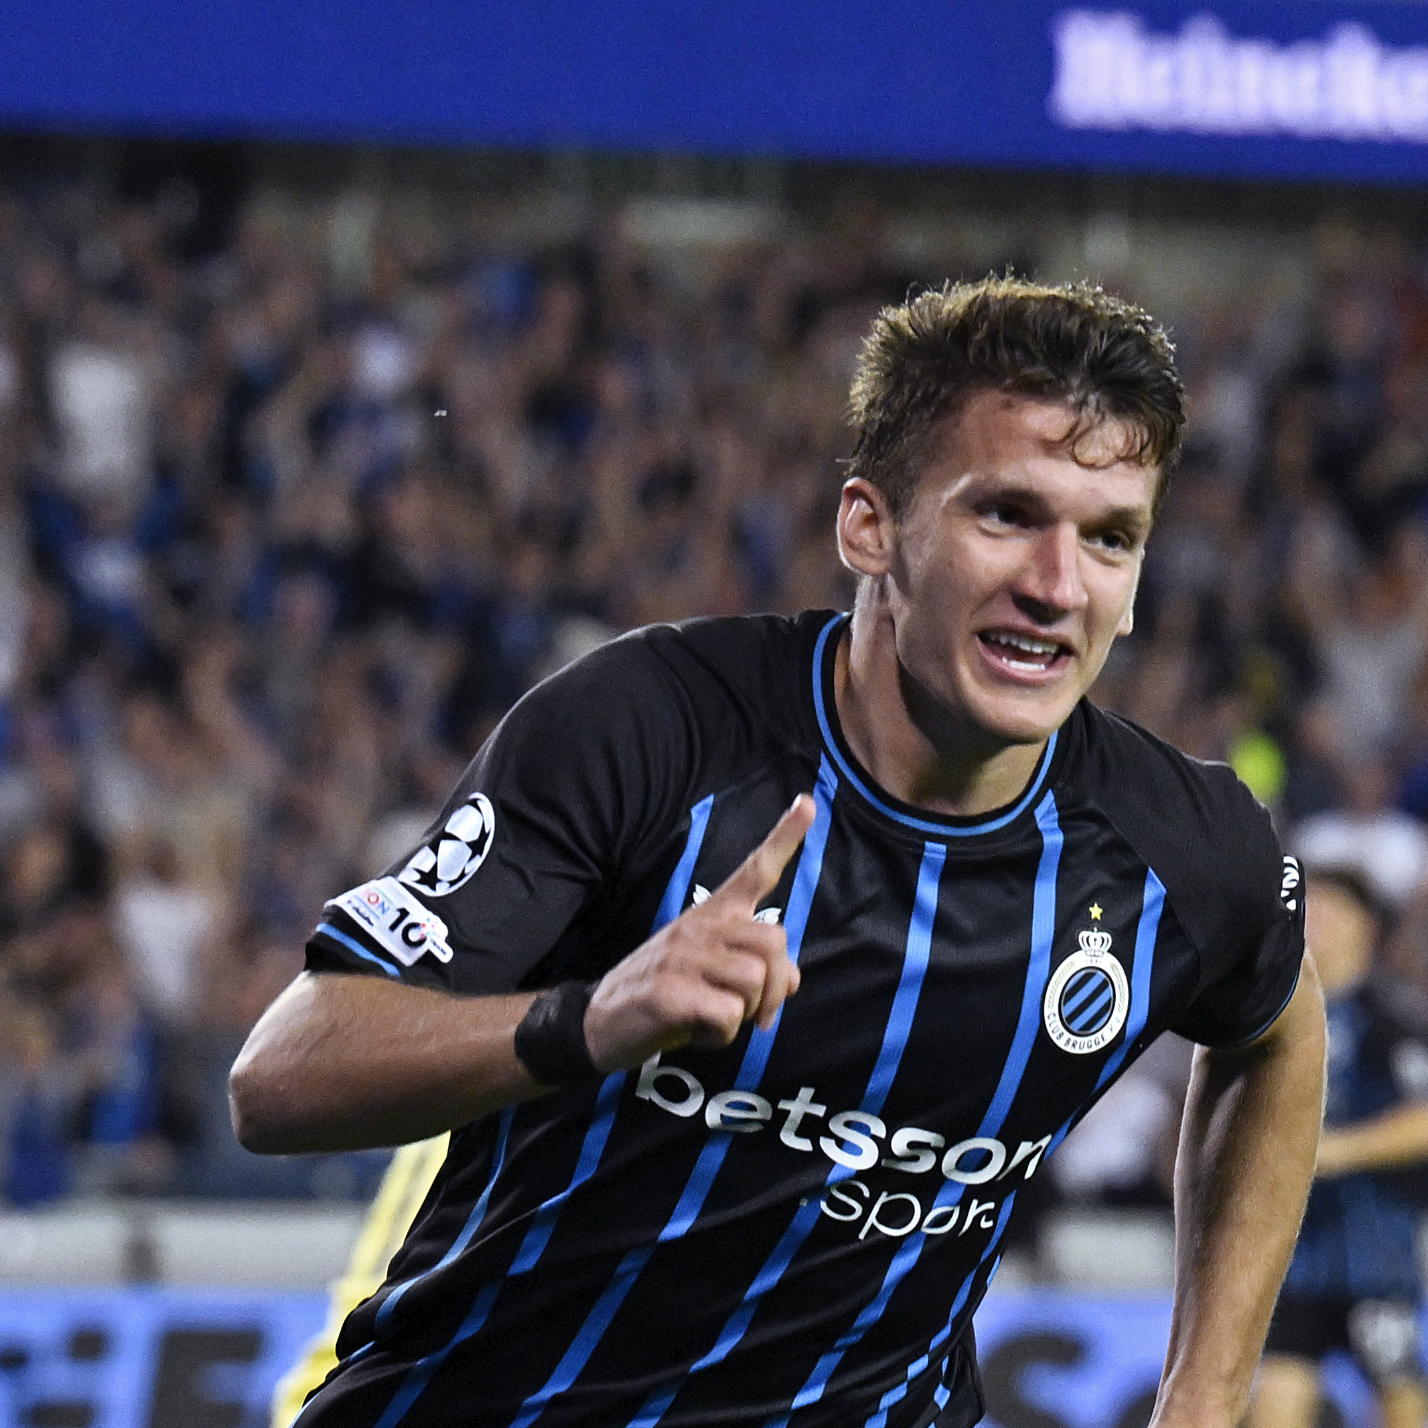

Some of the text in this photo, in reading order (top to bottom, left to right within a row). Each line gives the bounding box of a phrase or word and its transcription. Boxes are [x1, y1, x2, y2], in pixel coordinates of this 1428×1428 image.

[388, 907, 428, 948] 10
[1048, 1012, 1064, 1040] CLUB
[1064, 1034, 1106, 1050] BRUGGE
[635, 1051, 1053, 1186] betsson
